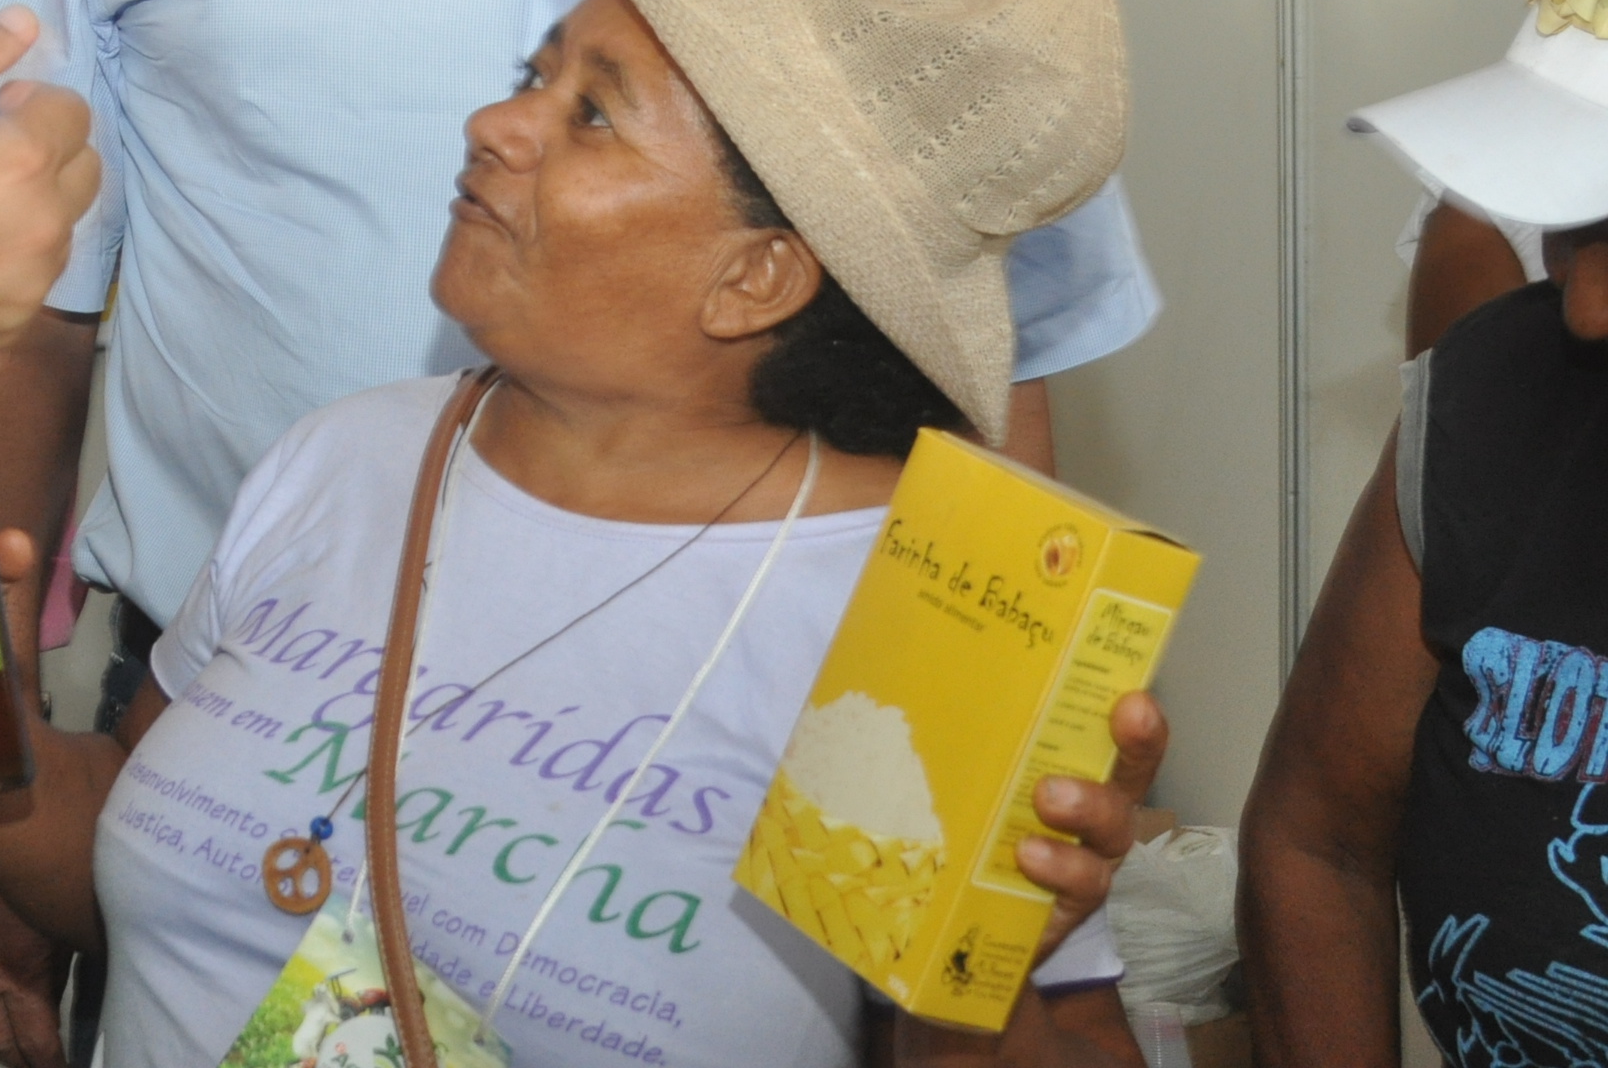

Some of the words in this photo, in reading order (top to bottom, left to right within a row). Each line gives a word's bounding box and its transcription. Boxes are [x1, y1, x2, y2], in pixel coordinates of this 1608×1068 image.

[880, 518, 941, 580] Farinha
[947, 561, 972, 597] de
[978, 574, 1054, 650] Babaçu
[231, 709, 283, 740] em
[263, 720, 702, 954] Marcha
[432, 907, 487, 947] com
[503, 983, 667, 1067] Liberdade.
